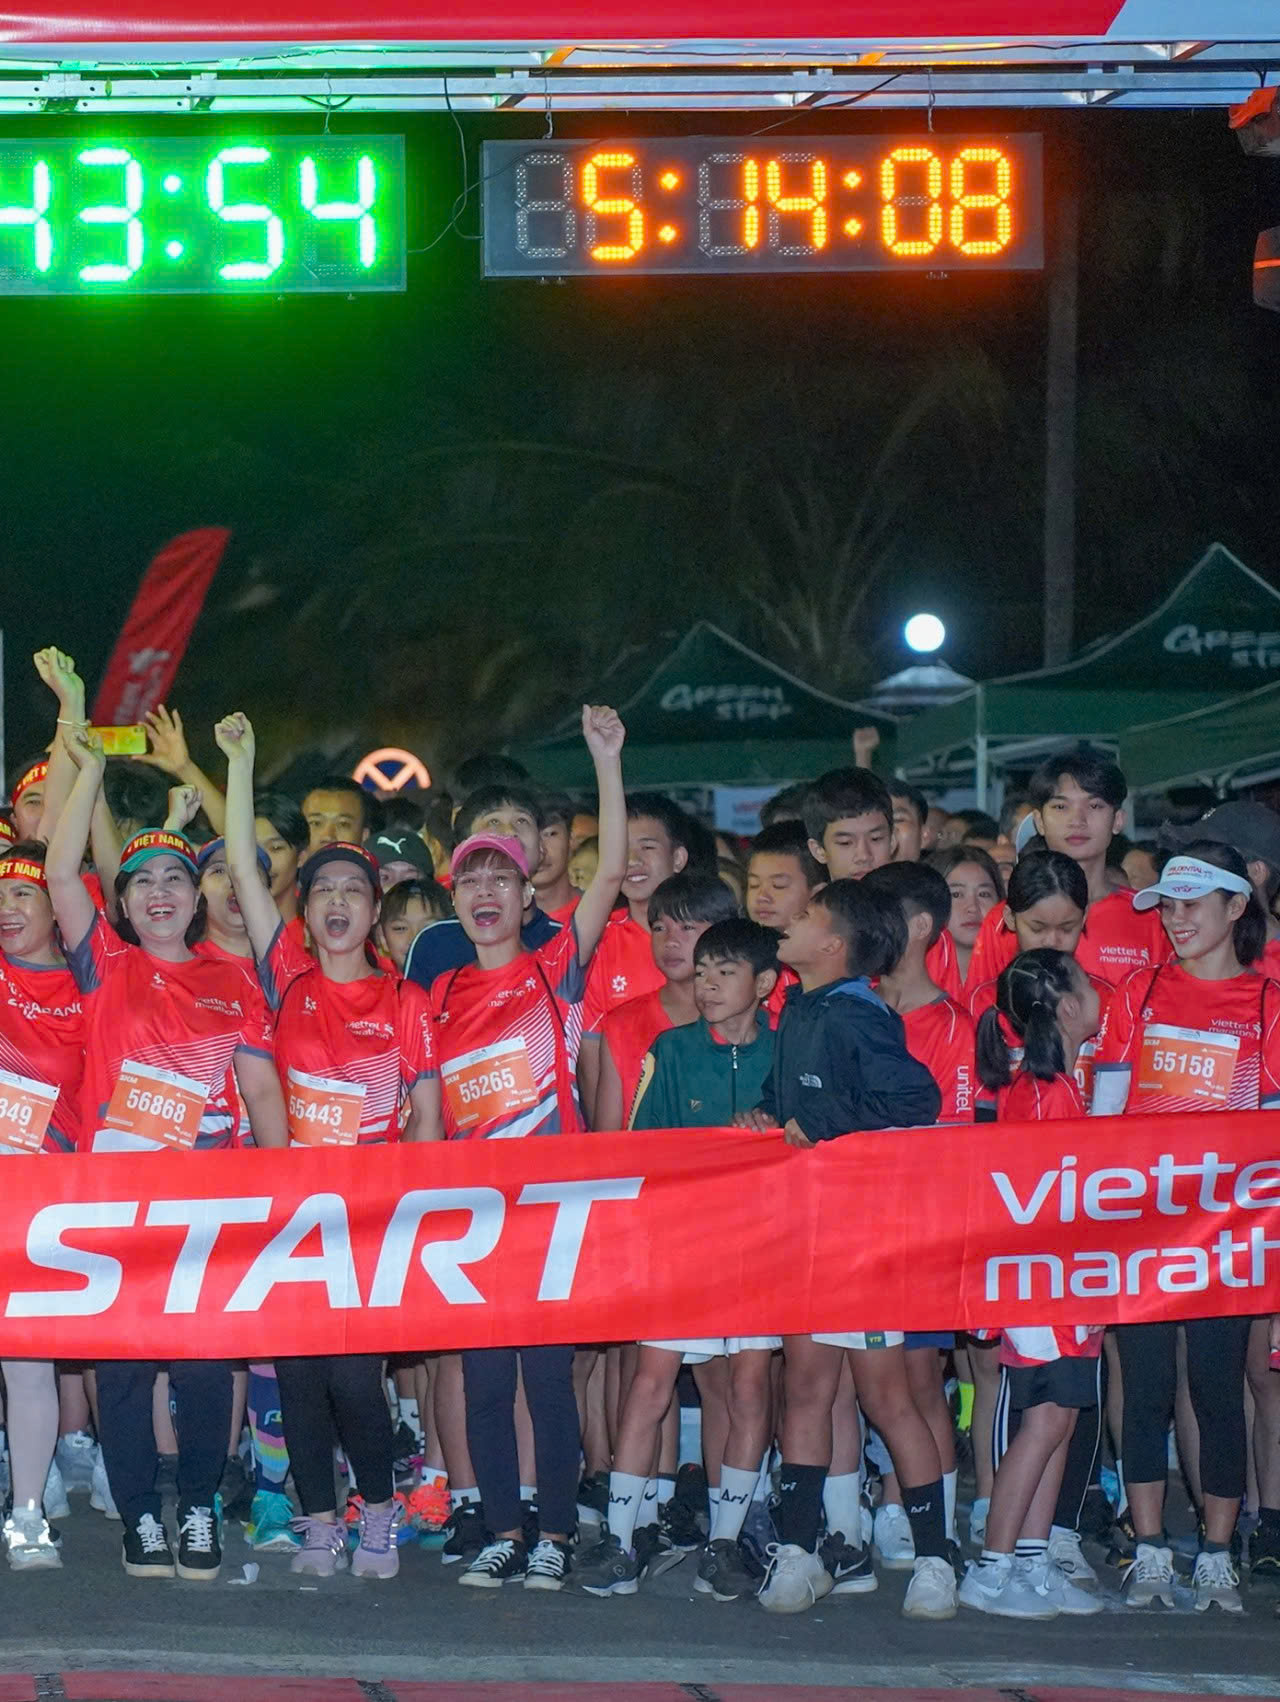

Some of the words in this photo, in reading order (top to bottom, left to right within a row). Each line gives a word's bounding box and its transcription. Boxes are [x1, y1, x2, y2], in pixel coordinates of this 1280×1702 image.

[582, 147, 1012, 262] 5:14:08
[158, 833, 184, 849] NAM
[14, 861, 41, 879] NAM
[1099, 946, 1137, 957] viettel
[1099, 954, 1146, 966] marathon
[1210, 1019, 1250, 1031] viettel
[1153, 1050, 1216, 1079] 55158
[459, 1067, 516, 1104] 55265
[955, 1065, 973, 1115] unitel
[126, 1088, 187, 1124] 56868
[289, 1095, 343, 1127] 55443
[3, 1176, 645, 1318] START
[721, 1488, 749, 1505] Ari
